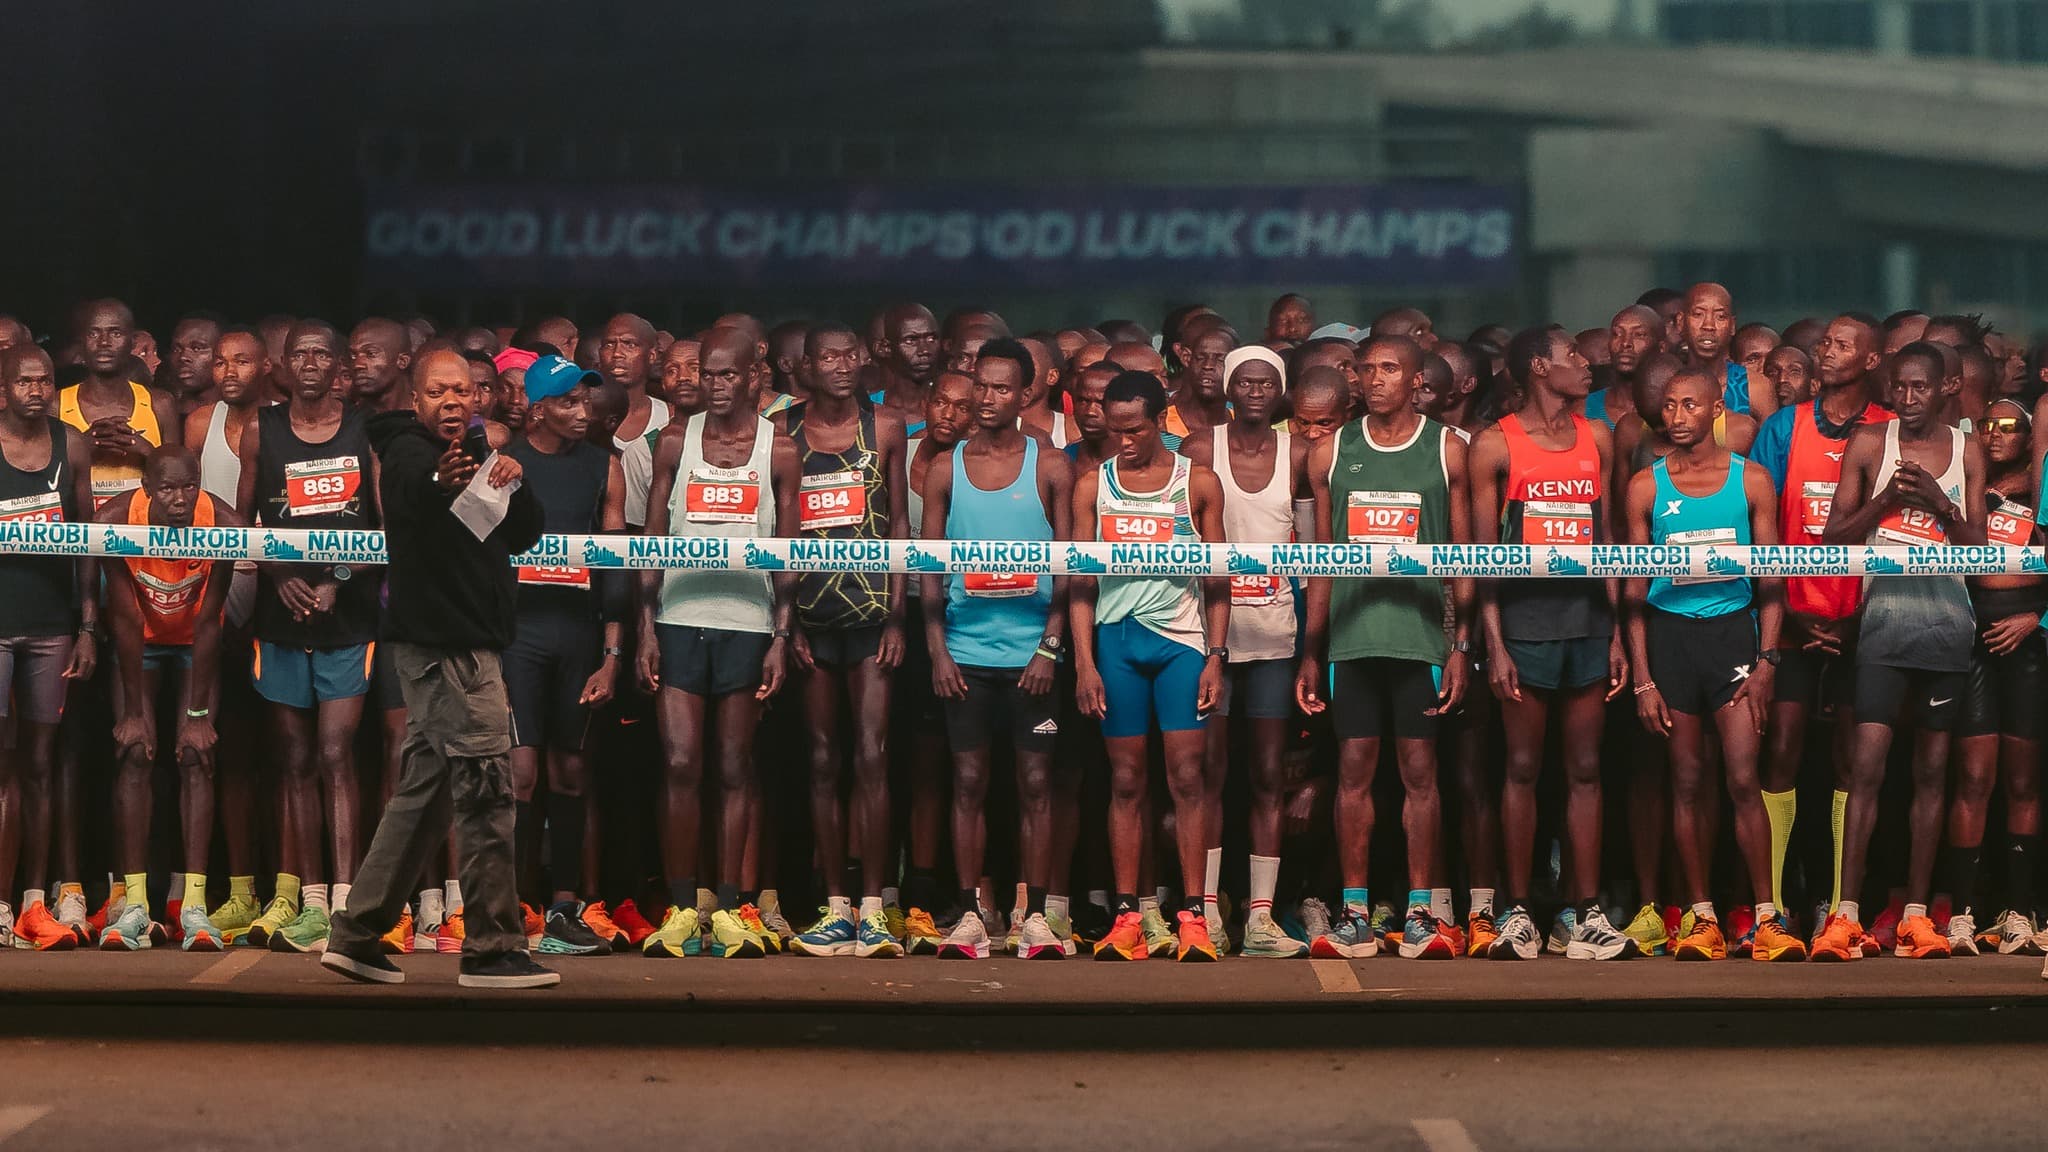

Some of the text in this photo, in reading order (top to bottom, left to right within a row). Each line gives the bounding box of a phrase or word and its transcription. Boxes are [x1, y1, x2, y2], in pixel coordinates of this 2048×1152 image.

[367, 210, 975, 258] GOOD LUCK CHAMPS
[982, 210, 1514, 258] OD LUCK CHAMPS
[709, 469, 739, 478] NAIROBI
[810, 473, 842, 482] NAIROBI
[303, 476, 345, 496] 863
[1527, 480, 1594, 499] KENYA
[702, 486, 744, 504] 883
[807, 490, 850, 510] 884
[1546, 502, 1576, 510] NAIROBI
[1809, 500, 1832, 517] 13
[1364, 509, 1404, 526] 107
[1901, 507, 1936, 529] 127
[1989, 515, 2017, 534] 64
[1115, 518, 1157, 536] 540
[1542, 520, 1579, 537] 114
[1685, 530, 1715, 539] NAIROBI
[148, 527, 248, 549] NAIROBI
[308, 530, 385, 552] NAIRO
[0, 543, 88, 553] TY MARATHON
[148, 548, 248, 558] CITY MARATHON
[628, 537, 729, 558] NAIROBI
[789, 539, 890, 560] NAIROBI
[950, 541, 1051, 562] NAIROBI
[1111, 543, 1211, 563] NAIROBI
[1271, 544, 1372, 564] NAIROBI
[1431, 545, 1532, 565] NAIROBI
[1591, 546, 1691, 565] NAIROBI
[1750, 546, 1849, 565] NAIROBI
[1908, 546, 2006, 564] NAIROBI
[308, 552, 390, 562] CITY MARATH
[509, 556, 568, 566] ARATHON
[628, 559, 729, 568] CITY MARATHON
[789, 561, 890, 571] CITY MARATHON
[950, 563, 1051, 572] CITY MARATHON
[1111, 565, 1211, 574] CITY MARATHON
[1271, 566, 1372, 575] CITY MARATHON
[1431, 566, 1532, 575] CITY MARATHON
[1591, 566, 1691, 575] CITY MARATHON
[1750, 566, 1849, 574] CITY MARATHON
[1908, 565, 2006, 573] CITY MARATHON
[145, 587, 193, 604] 1347
